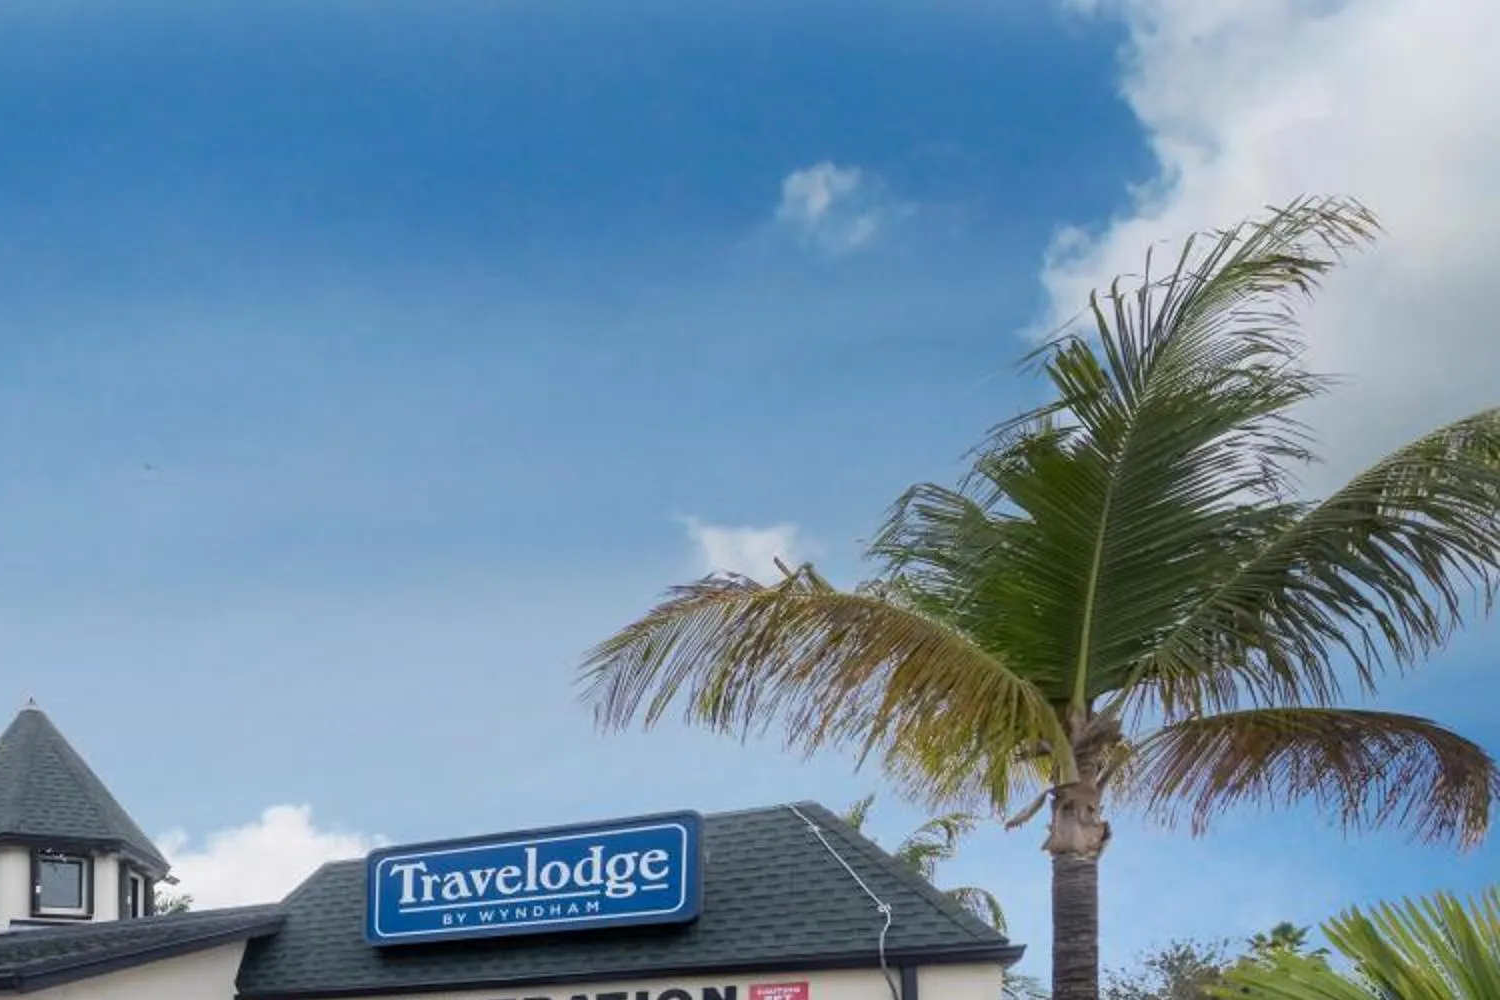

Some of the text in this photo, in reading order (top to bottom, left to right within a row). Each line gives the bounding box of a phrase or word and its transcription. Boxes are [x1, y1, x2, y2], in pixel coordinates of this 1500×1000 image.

[390, 846, 669, 903] Travelodge
[443, 901, 600, 926] BY WYNDHAM
